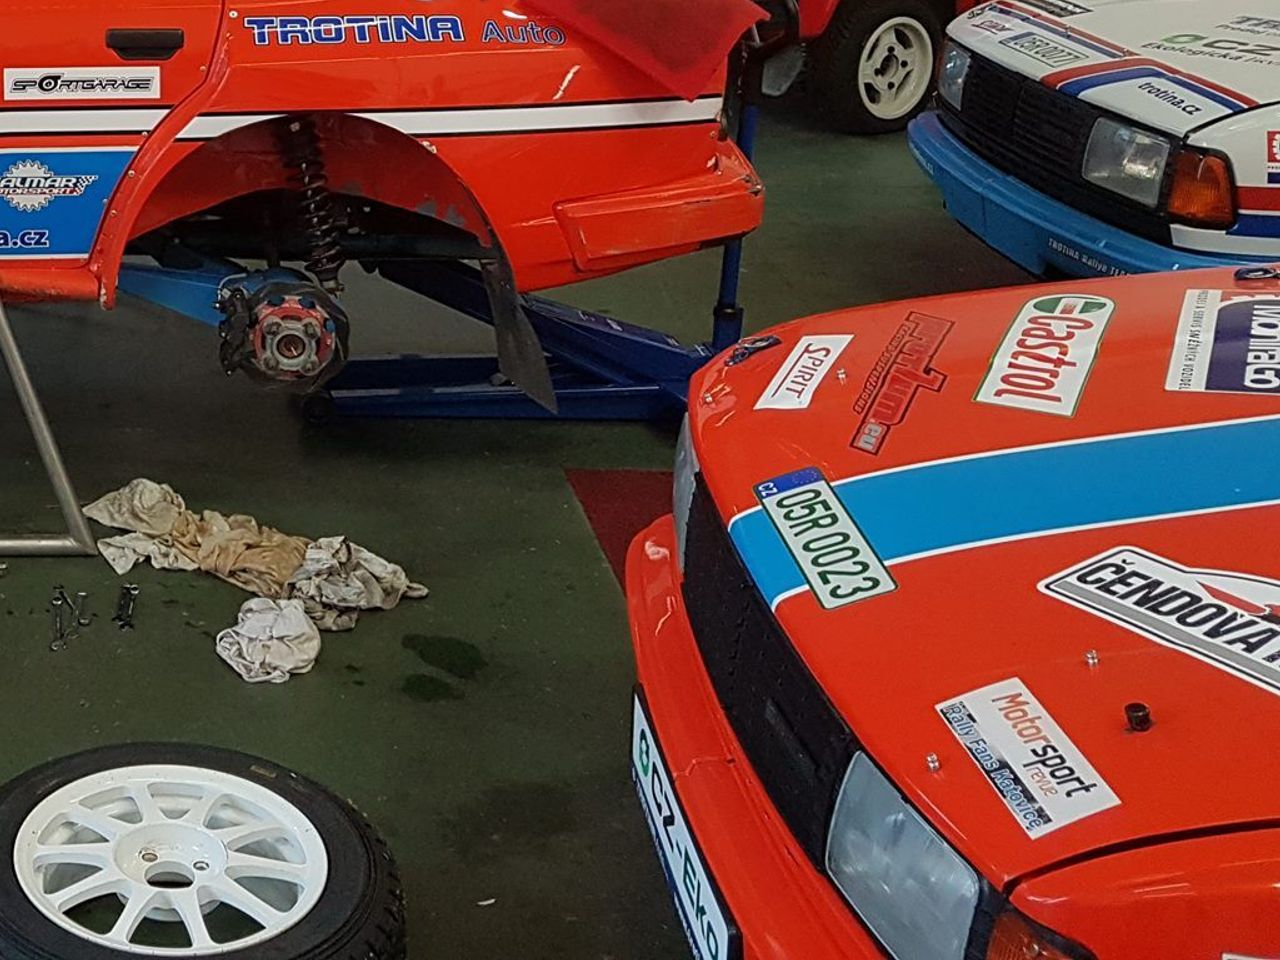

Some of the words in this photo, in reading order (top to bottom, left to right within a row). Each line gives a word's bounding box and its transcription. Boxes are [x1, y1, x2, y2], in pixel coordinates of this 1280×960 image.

[244, 14, 465, 45] TROTINA
[481, 20, 566, 44] Auto
[1138, 82, 1202, 116] trotina.cz
[785, 342, 831, 399] SPIRIT
[993, 315, 1094, 402] Castrol
[758, 482, 778, 497] CZ
[945, 703, 976, 740] Rally
[969, 737, 1000, 772] Fans
[991, 768, 1044, 831] Katovice
[1026, 767, 1058, 797] revue
